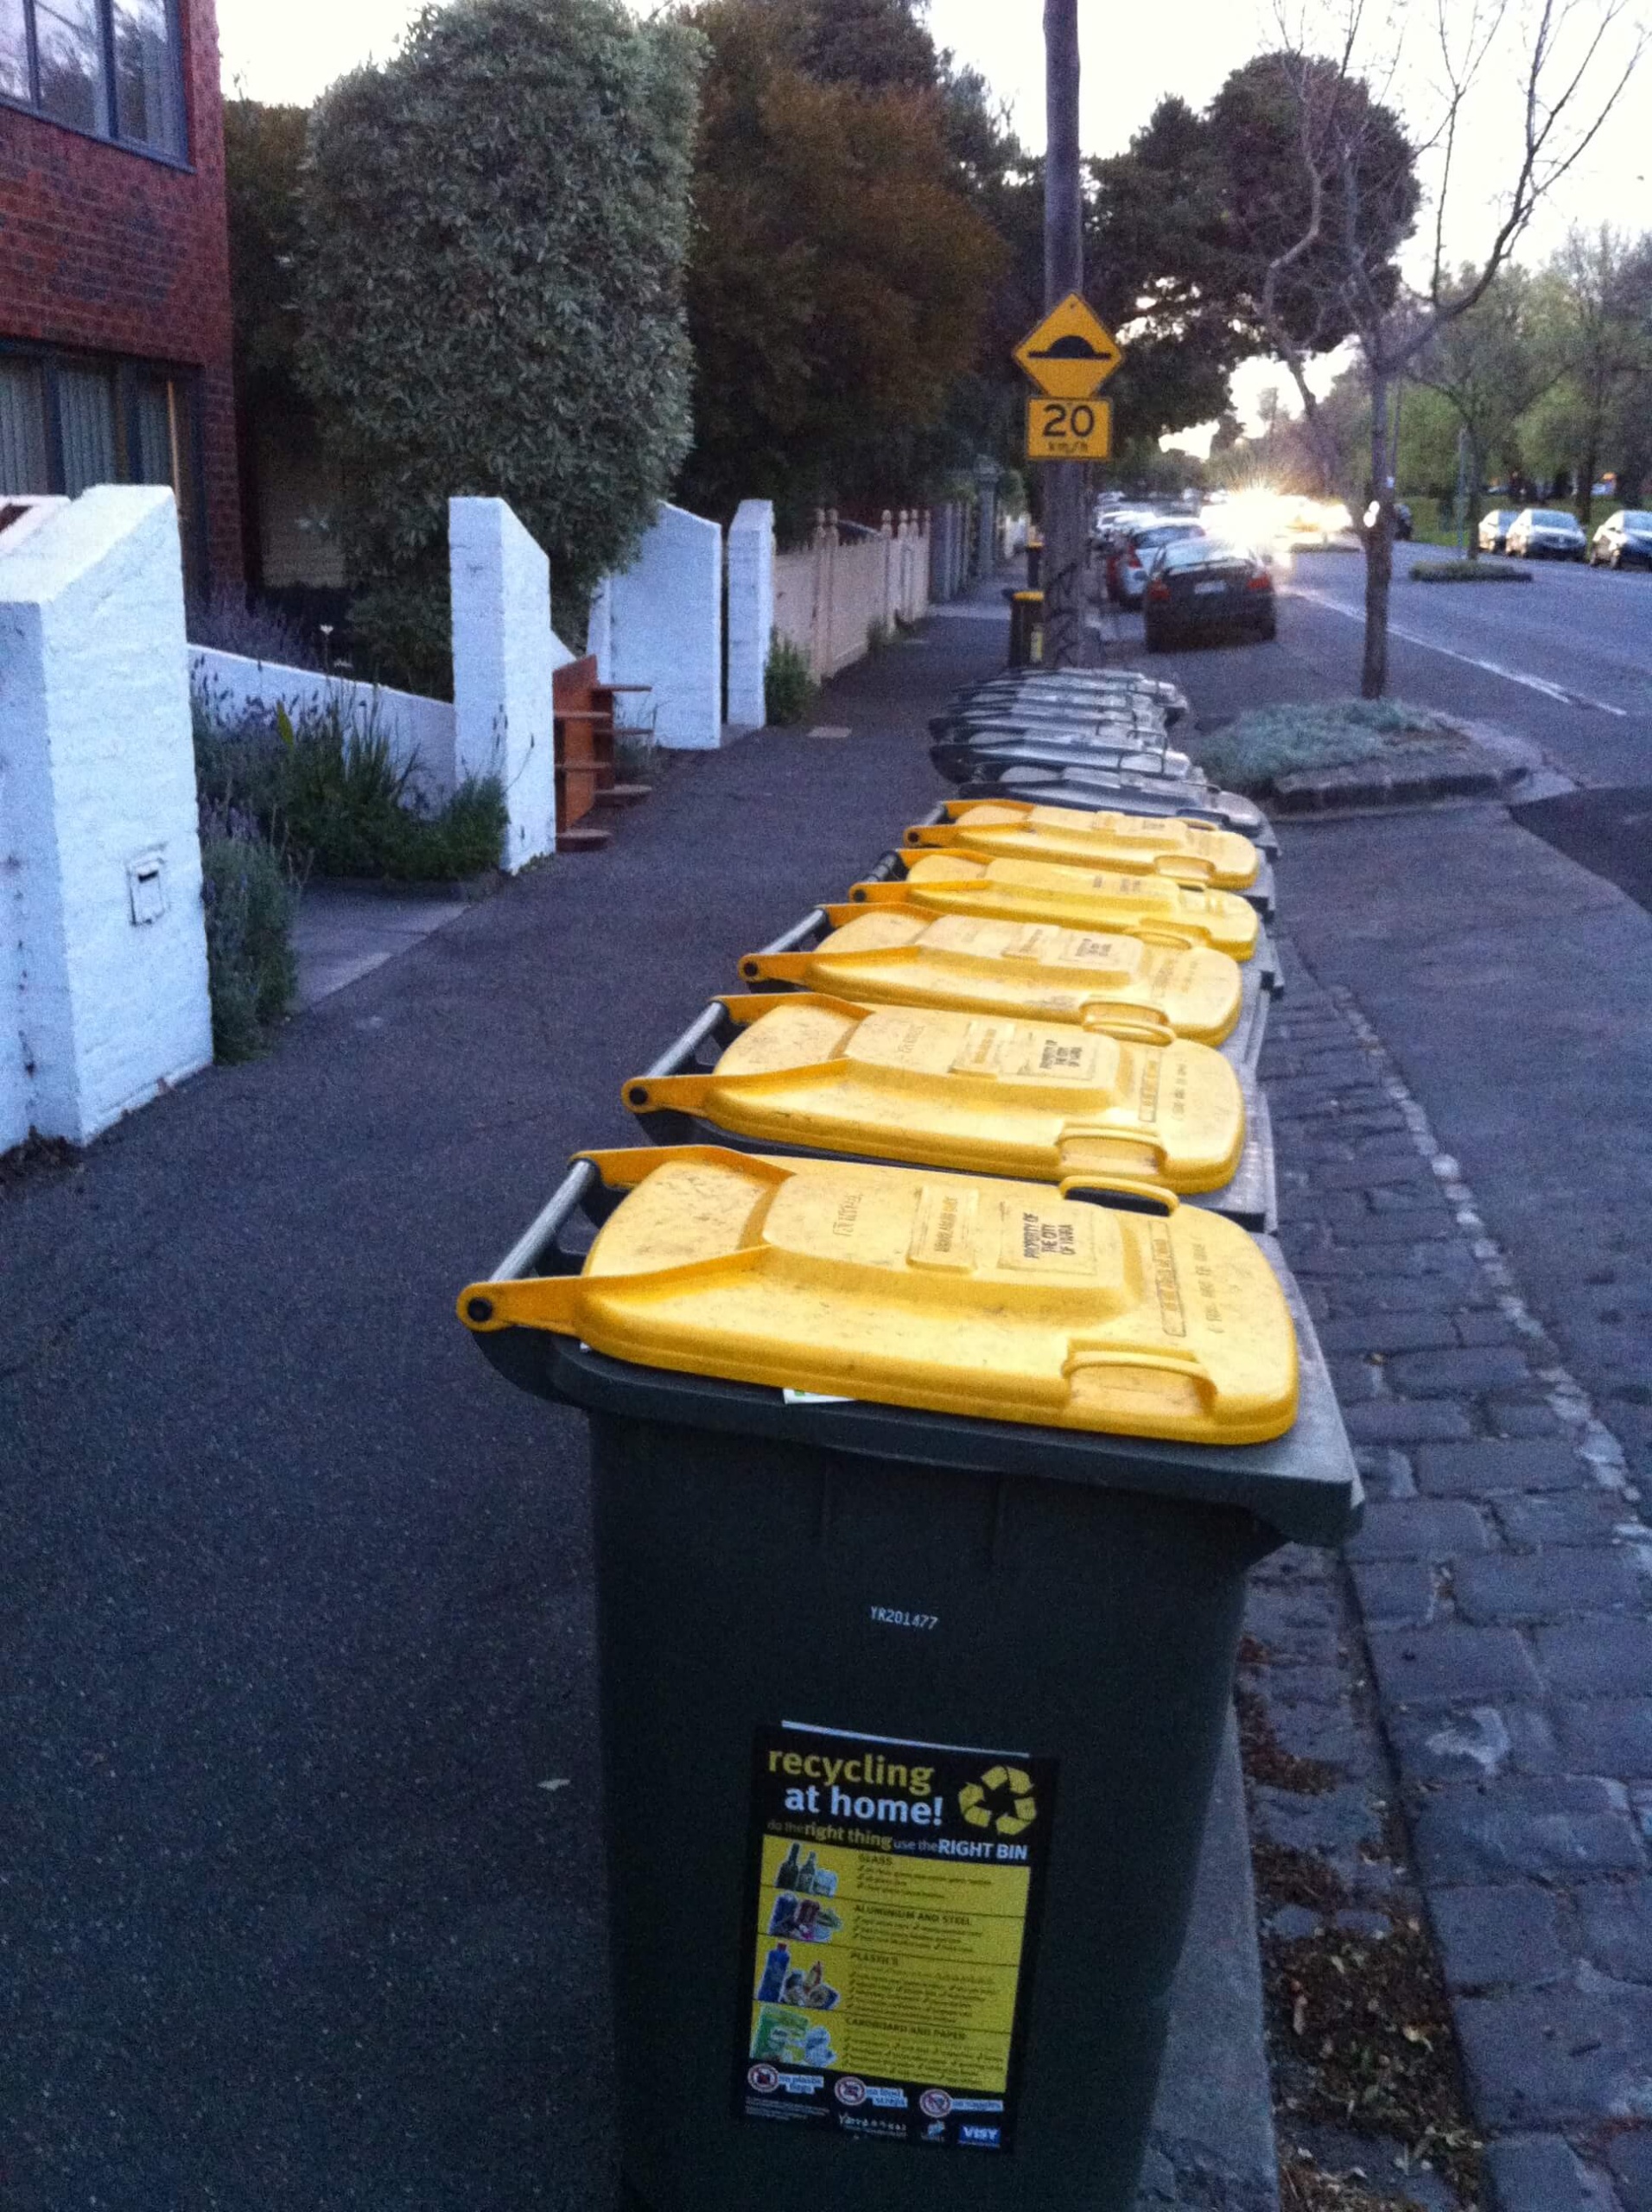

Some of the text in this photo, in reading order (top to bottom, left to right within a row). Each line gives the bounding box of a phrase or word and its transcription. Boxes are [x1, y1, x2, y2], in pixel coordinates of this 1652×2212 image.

[1043, 404, 1095, 436] 20
[871, 1605, 938, 1630] YR201477
[769, 1750, 934, 1796] recycling
[785, 1784, 943, 1826] at home!
[804, 1821, 845, 1844] right
[848, 1827, 893, 1852] thing
[893, 1840, 916, 1851] use
[918, 1840, 938, 1853] the
[938, 1839, 992, 1858] RIGHT
[997, 1844, 1027, 1859] BIN
